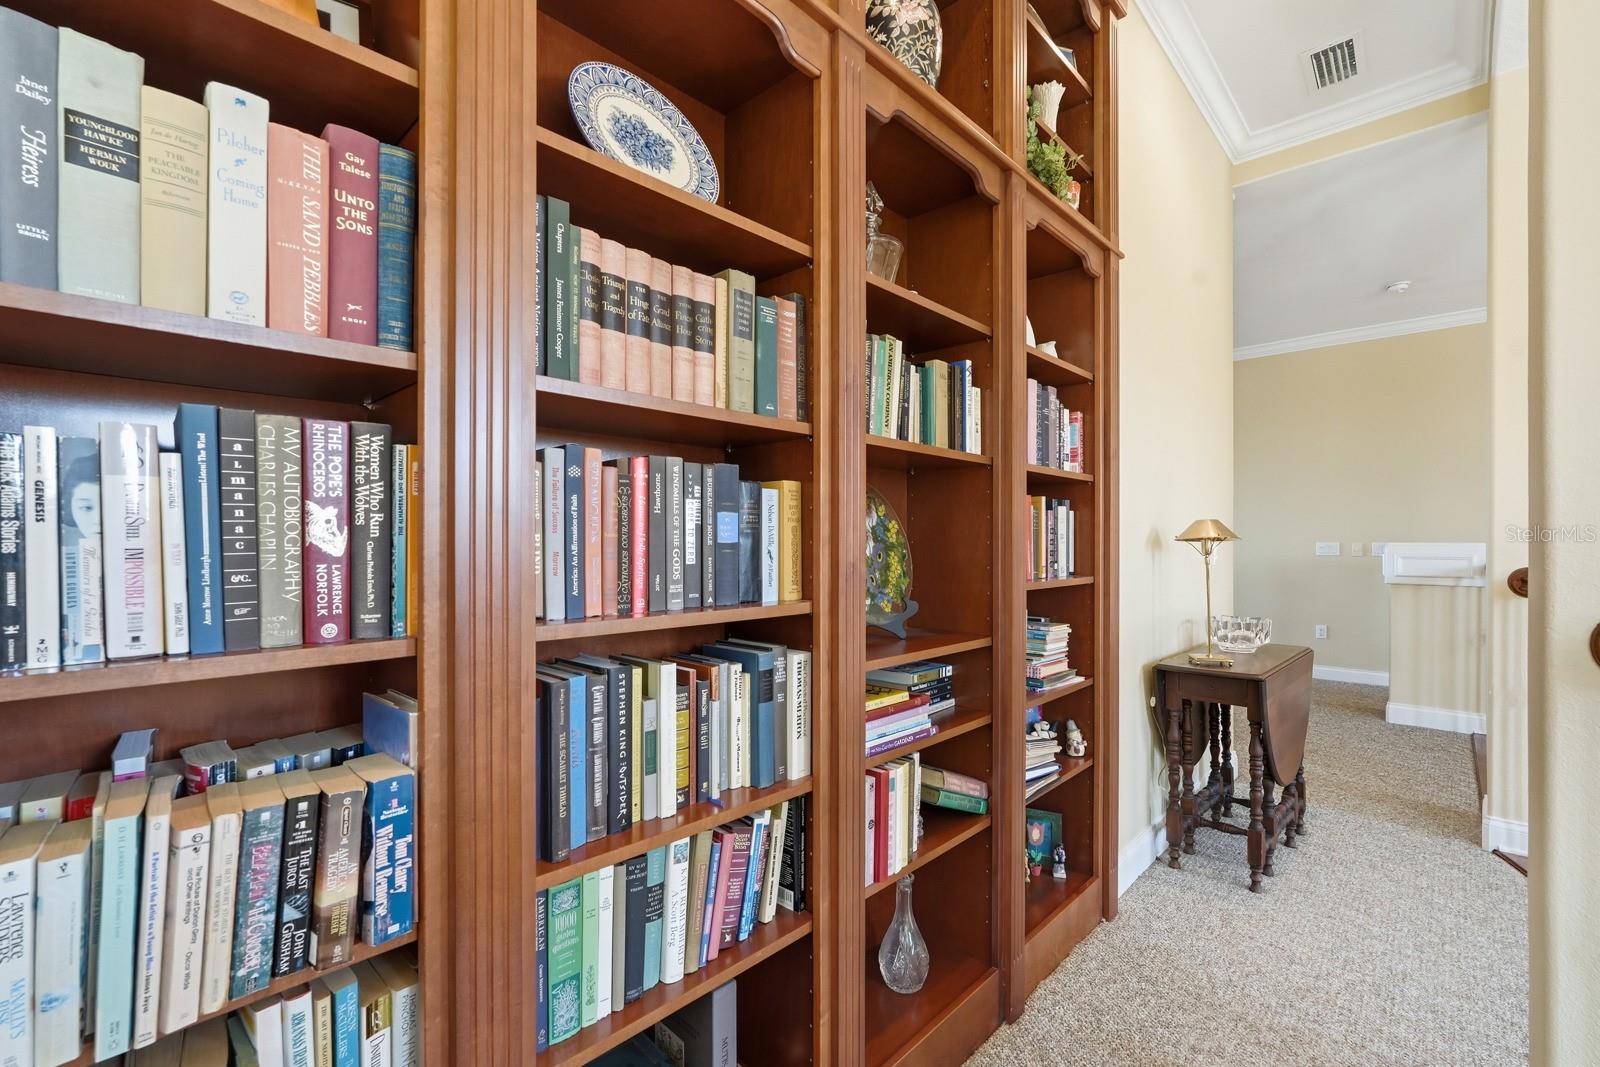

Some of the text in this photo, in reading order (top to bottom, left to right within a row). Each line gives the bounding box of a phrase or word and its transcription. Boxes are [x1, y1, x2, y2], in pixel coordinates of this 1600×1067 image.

[15, 84, 51, 106] Dailey
[20, 74, 49, 94] Janet
[67, 114, 138, 143] YOUNGBLOOD
[84, 128, 124, 148] HAWKE
[217, 127, 264, 157] Pilcher
[20, 125, 48, 188] Heiress
[80, 144, 127, 165] HERMAN
[88, 156, 120, 172] WOUK
[345, 152, 366, 166] Gay
[151, 166, 200, 187] KINGDOM
[216, 168, 264, 200] Coming
[338, 160, 372, 180] Talese
[224, 189, 259, 210] Home
[334, 188, 375, 212] UNTO
[342, 207, 368, 222] THE
[302, 143, 322, 334] THE SAND PEBBLES
[336, 216, 374, 236] SONS
[556, 223, 564, 254] Chapters
[586, 284, 598, 296] the
[610, 292, 620, 301] and
[628, 309, 636, 320] of
[888, 341, 894, 352] AN
[196, 433, 206, 461] The Wind
[312, 424, 326, 498] RHINOCEROS
[328, 426, 342, 498] THE POPE'S
[354, 434, 369, 526] With the Wolves
[369, 434, 384, 538] Women Who Run
[552, 479, 560, 502] Failure
[654, 473, 662, 514] Hawthorne
[1, 440, 19, 554] The Nick Adams Stories
[34, 480, 46, 523] GENESIS
[258, 424, 277, 570] CHARLES CHAPLIN
[282, 426, 300, 602] MY AUTOBIOGRAPHY
[673, 516, 680, 527] OF
[687, 528, 694, 539] TO
[366, 541, 374, 579] Clarissa Pinkola
[552, 551, 560, 577] Morrow
[571, 556, 579, 566] An
[636, 532, 646, 589] Holly Springs
[672, 548, 680, 580] GODS
[6, 572, 16, 606] HEMINGWAY
[82, 546, 96, 637] Memoirs Geisha
[124, 548, 144, 610] IMPOSSIBLE
[200, 554, 212, 625] Anne Morrow Lindbergh
[316, 564, 328, 616] NORFOLK
[331, 564, 342, 615] LAWRENCE
[66, 582, 78, 610] GOLDEN
[591, 685, 605, 744] CAPITAL CRIMES
[617, 766, 627, 819] OUTSIDER
[150, 858, 159, 882] Portrait
[195, 866, 203, 877] The
[286, 856, 300, 889] JUROR
[300, 847, 312, 869] THE
[328, 851, 339, 892] TRAGEDY
[348, 862, 358, 874] AN
[374, 824, 394, 916] Without Remorse
[390, 835, 412, 894] Tom Clancy
[186, 868, 194, 880] and
[193, 878, 202, 899] Picture
[298, 869, 311, 889] LAST
[148, 903, 157, 921] Artist
[150, 892, 158, 902] the
[183, 900, 193, 924] Writings
[10, 892, 29, 959] Lawrence
[191, 906, 200, 927] Dorian
[330, 906, 340, 934] DREISER
[338, 901, 348, 936] THEODORE
[538, 896, 546, 951] AMERICAN
[667, 900, 679, 948] Scott Berg
[145, 937, 155, 956] Young
[190, 928, 199, 944] Gray
[244, 905, 267, 974] THE CAROUSEL
[280, 923, 294, 974] GRISHAM
[293, 929, 307, 958] JOHN
[183, 951, 193, 990] Oscar Wilde
[142, 973, 153, 1013] James Joyce
[10, 978, 26, 1040] McNALLY'S
[347, 992, 356, 1031] CARSON
[401, 994, 410, 1036] PYNCHON
[339, 1003, 348, 1058] McCULLERS
